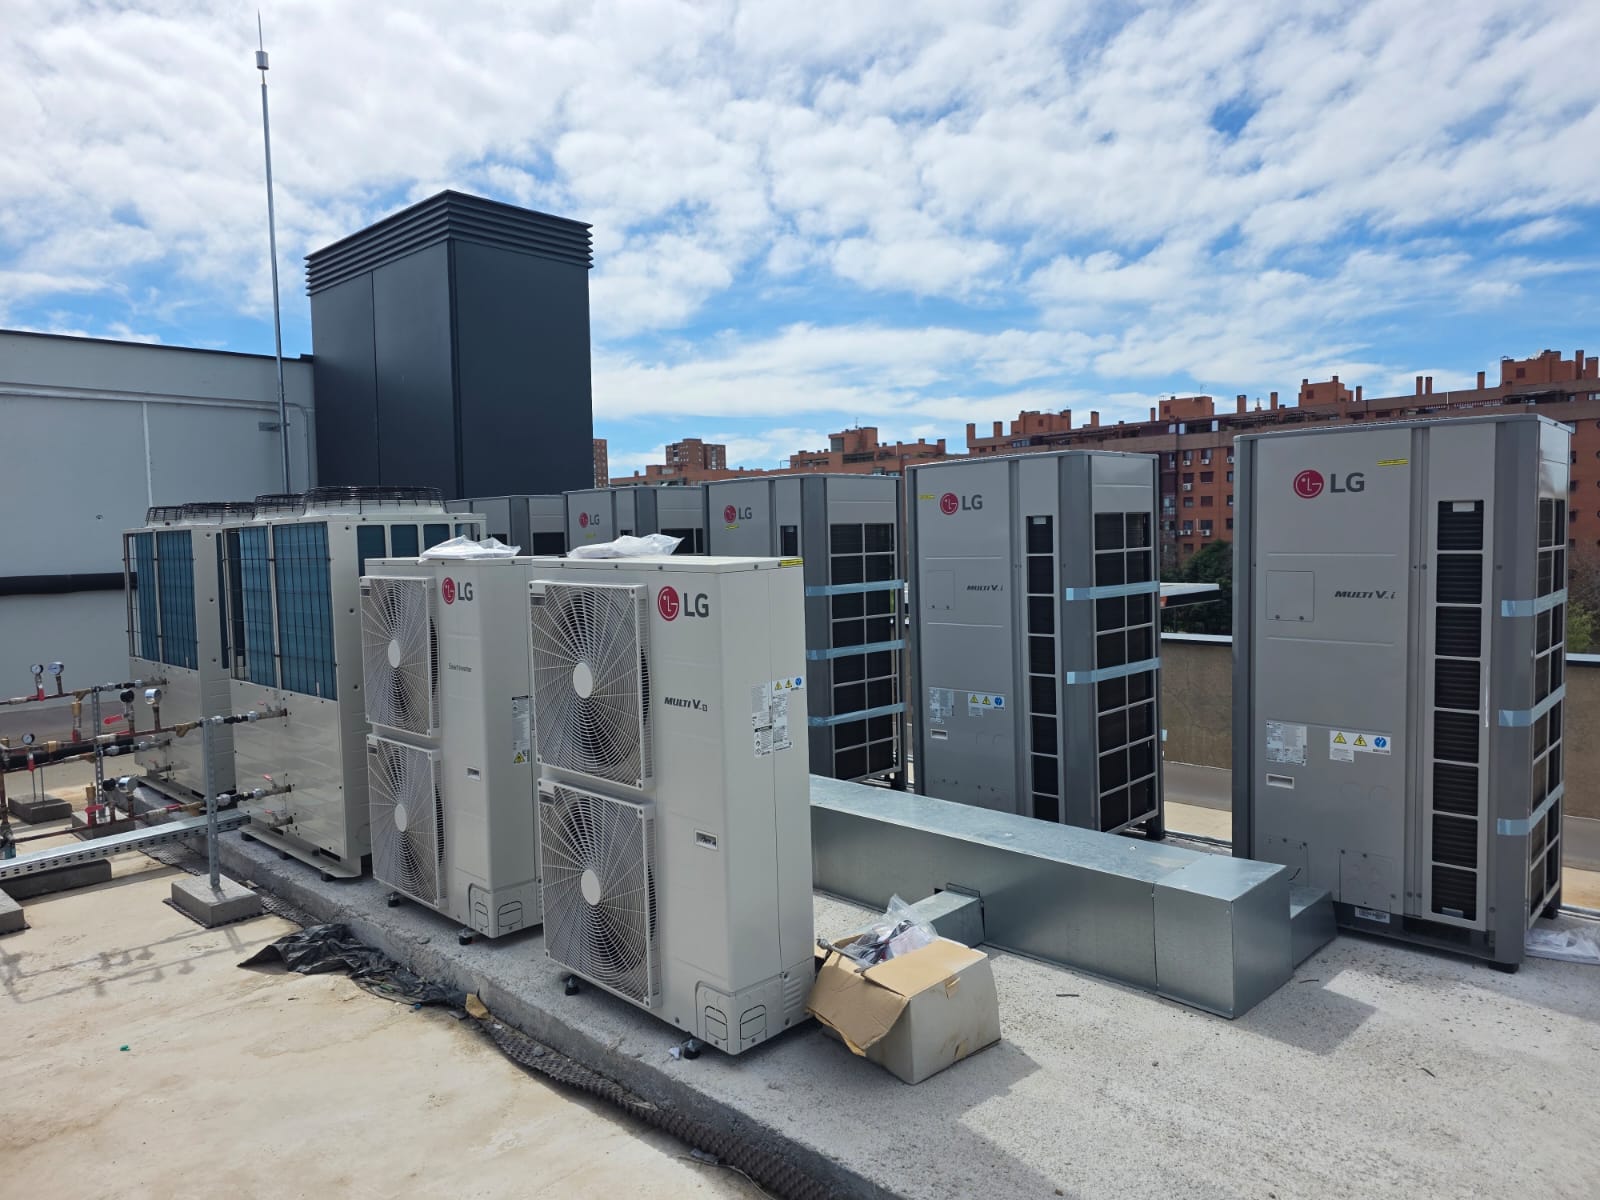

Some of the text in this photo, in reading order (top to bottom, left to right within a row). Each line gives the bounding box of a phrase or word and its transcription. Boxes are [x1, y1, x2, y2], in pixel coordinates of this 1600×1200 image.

[1330, 472, 1365, 493] LG
[961, 494, 983, 511] LG
[589, 513, 600, 525] LG
[738, 506, 753, 520] LG
[457, 581, 473, 601] LG
[1334, 590, 1373, 599] MULTI
[683, 592, 709, 618] LG
[664, 696, 691, 708] MULTI
